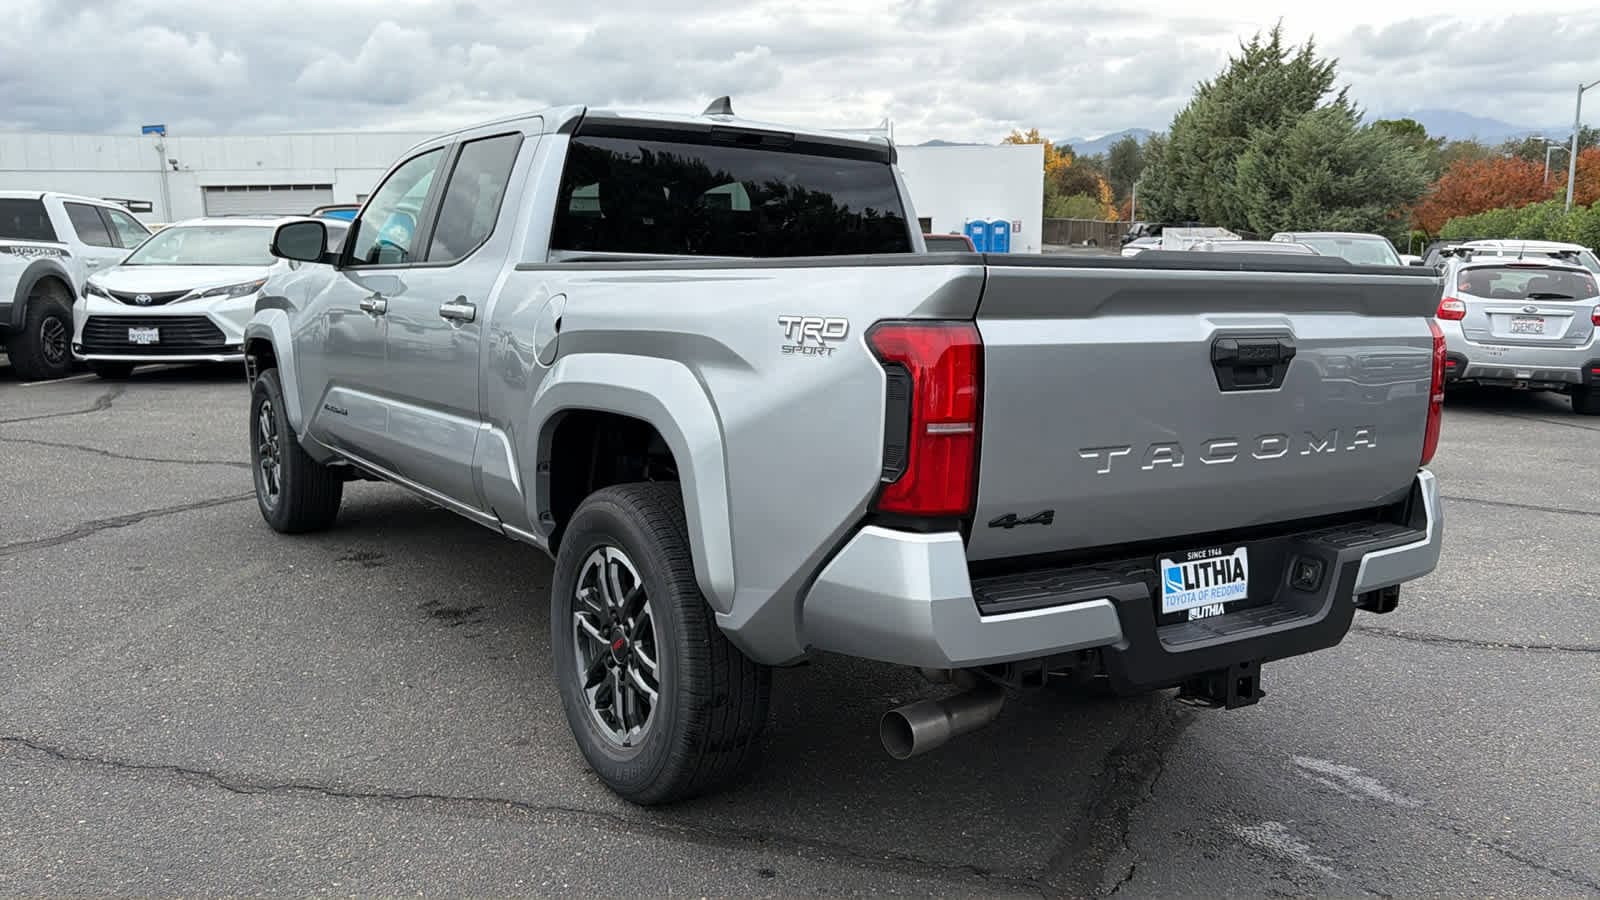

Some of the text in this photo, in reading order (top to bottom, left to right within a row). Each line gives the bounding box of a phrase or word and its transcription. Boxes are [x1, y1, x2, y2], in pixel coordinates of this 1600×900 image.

[778, 315, 849, 345] TRD
[782, 345, 836, 356] SPORT
[1079, 425, 1377, 474] TACOMA
[1187, 547, 1222, 560] SINCE 1946
[1182, 557, 1245, 591] LITHIA
[1166, 583, 1246, 607] TOYOTA OF REDDING
[1198, 603, 1225, 618] LITHIA
